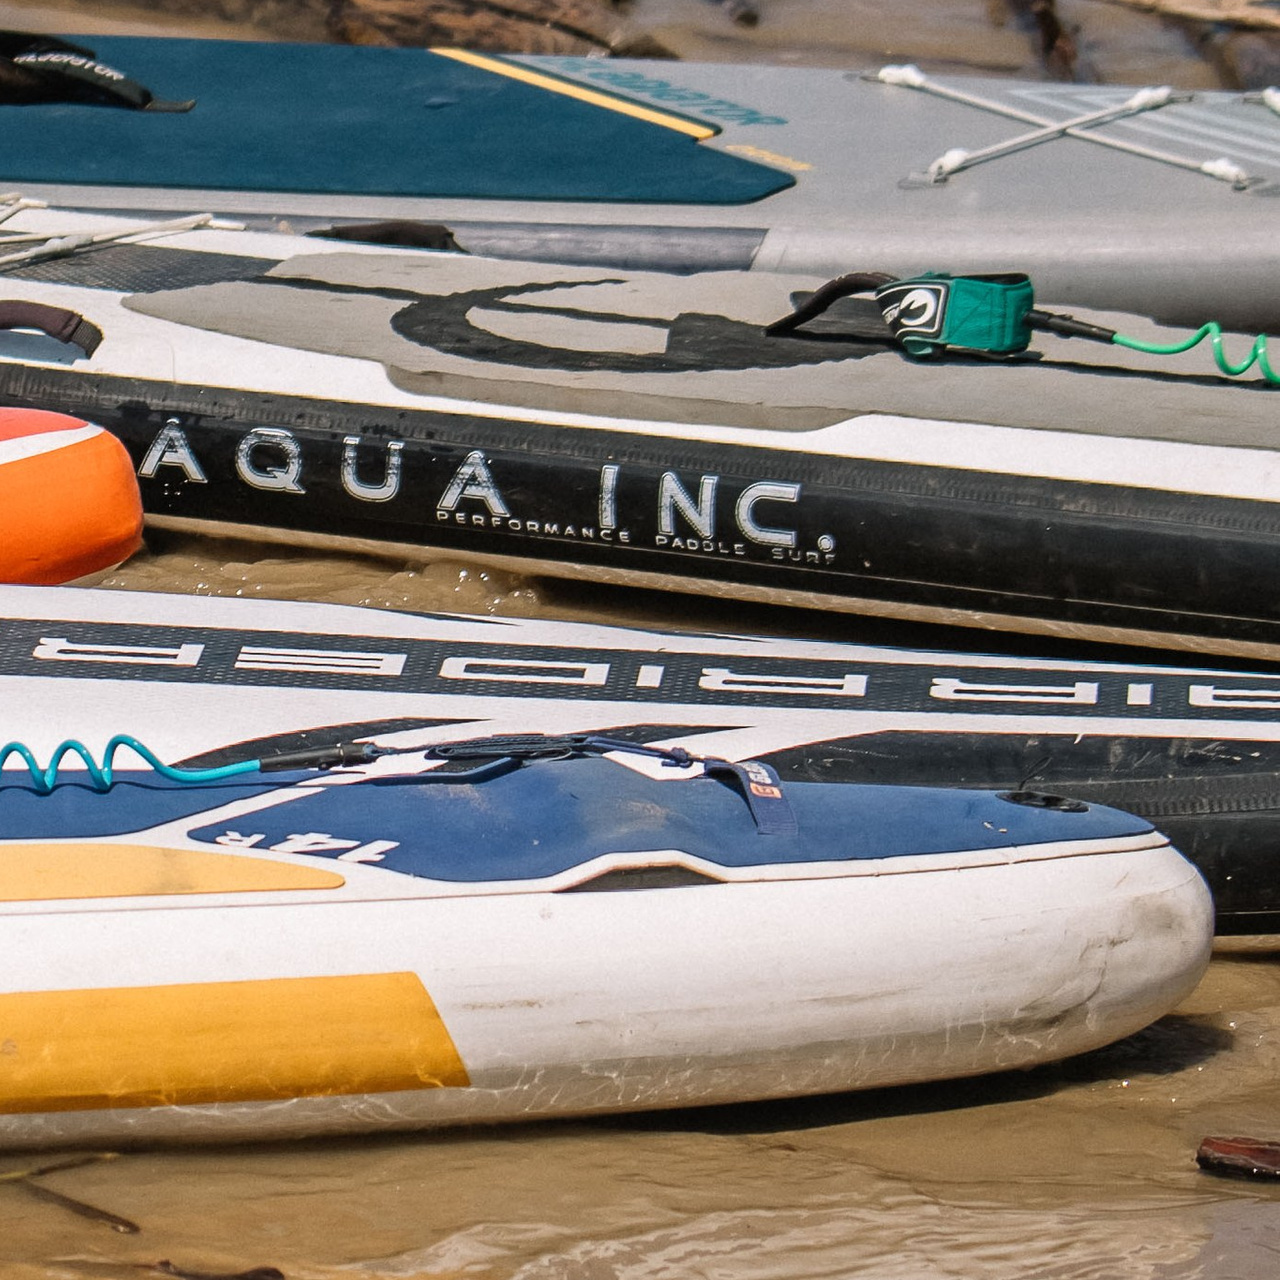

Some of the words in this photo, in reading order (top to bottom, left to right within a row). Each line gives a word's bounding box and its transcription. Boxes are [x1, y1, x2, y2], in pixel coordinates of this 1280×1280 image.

[138, 418, 512, 518] AQUA
[598, 464, 837, 554] INC.
[435, 510, 631, 543] PERFORMANCE
[655, 535, 747, 556] PADDLE
[770, 547, 837, 566] SURF
[32, 637, 869, 697] RIDER
